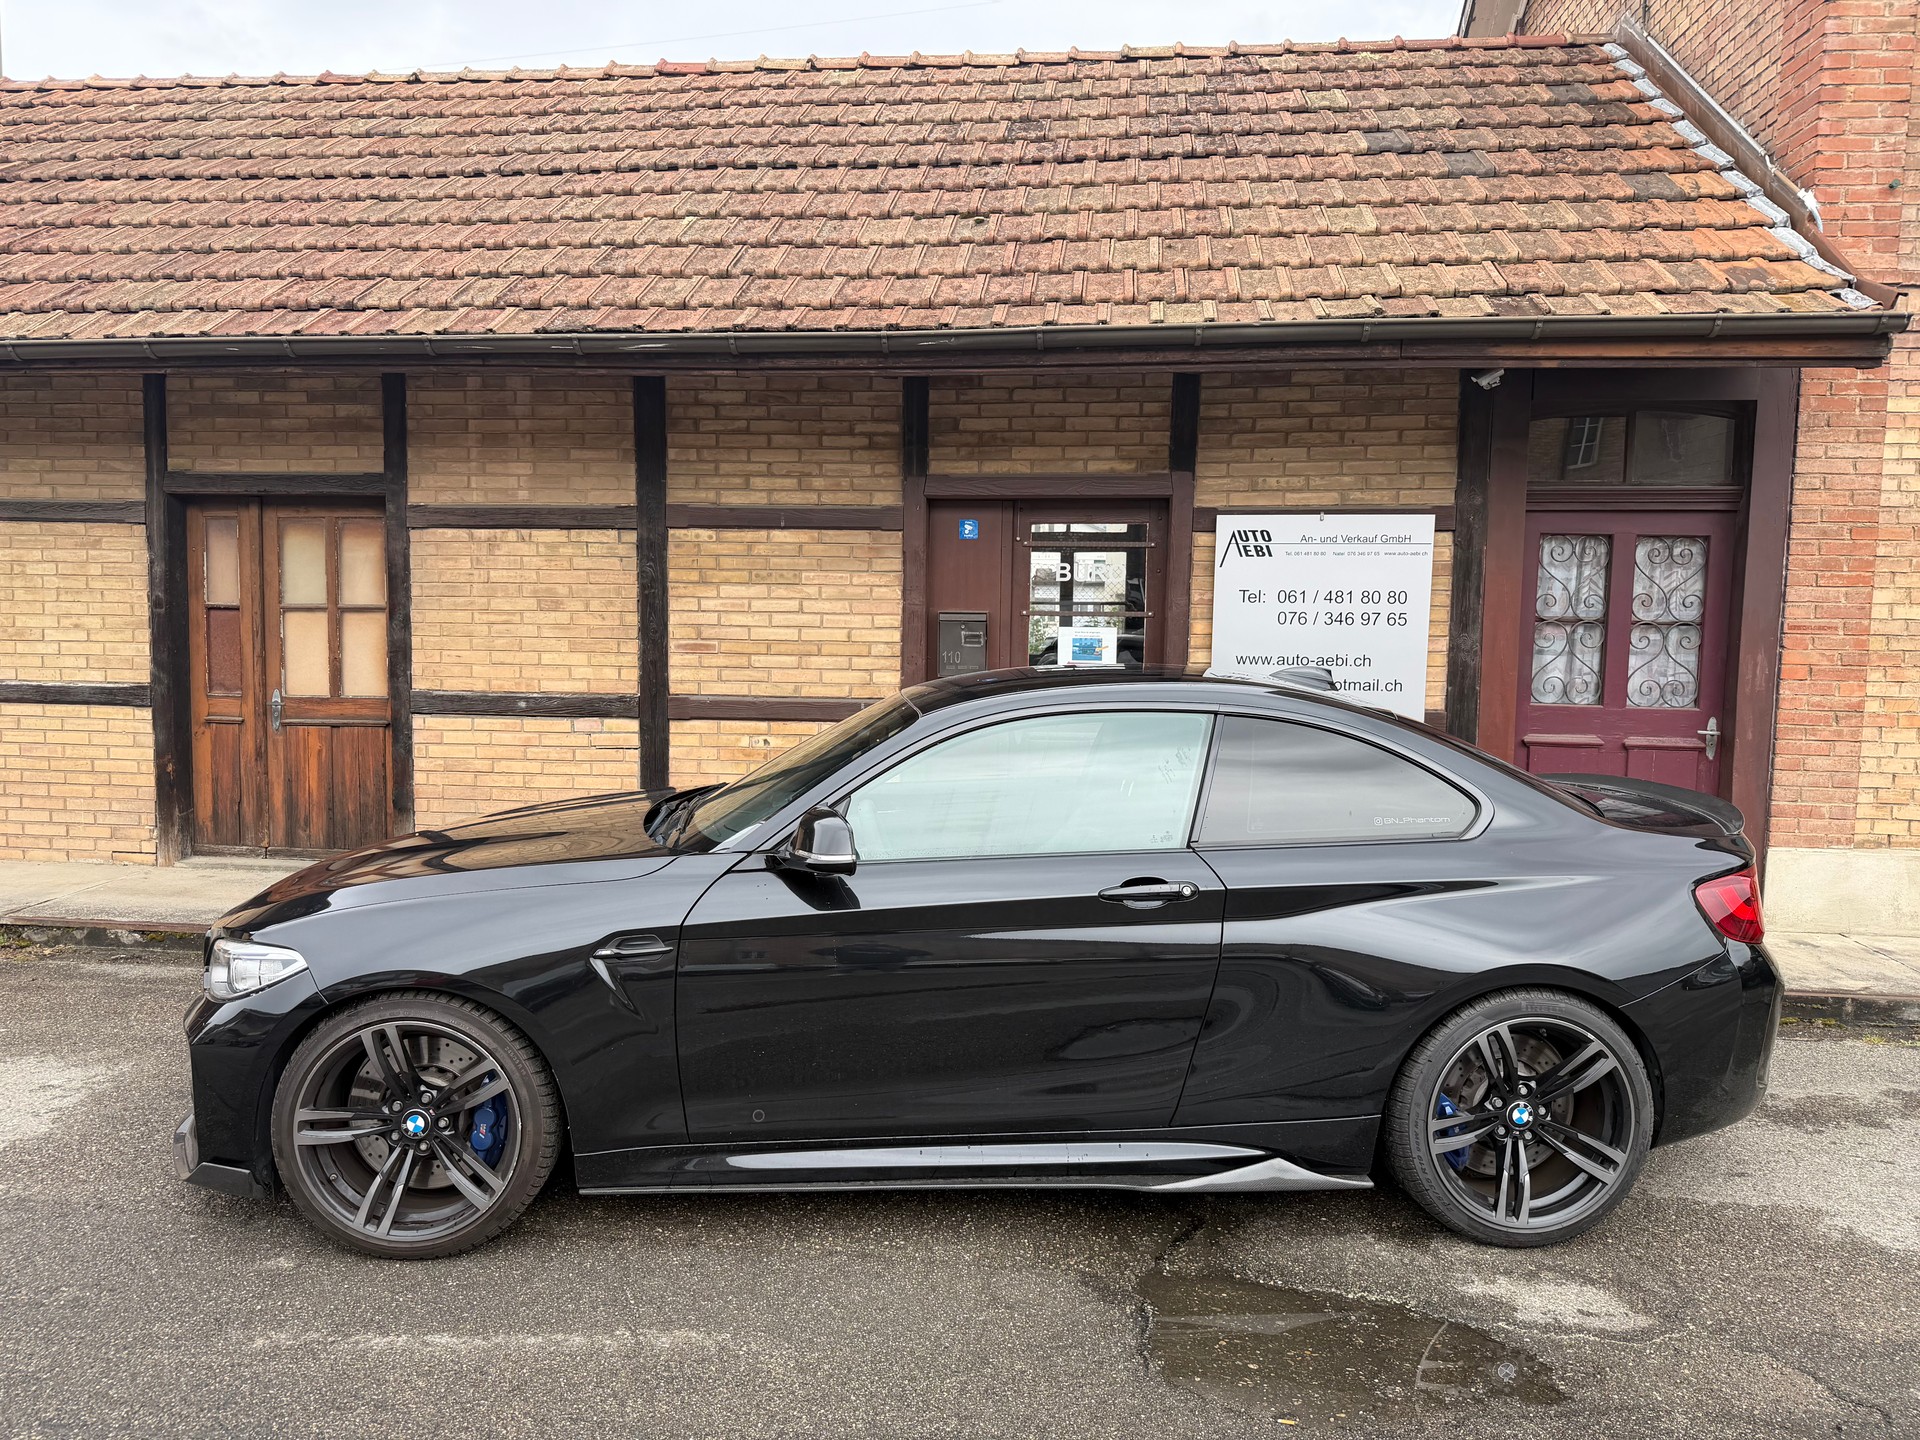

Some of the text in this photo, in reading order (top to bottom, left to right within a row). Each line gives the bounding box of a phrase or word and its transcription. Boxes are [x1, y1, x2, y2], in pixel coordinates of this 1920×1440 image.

[1300, 534, 1412, 543] An- und Verkauf GmbH
[1239, 590, 1407, 604] Tel: 061 / 481 80 80
[1278, 612, 1407, 626] 076 / 346 97 65
[942, 651, 961, 663] 110
[1236, 654, 1371, 668] www.auto-aebi.ch
[1333, 679, 1403, 692] otmail.ch
